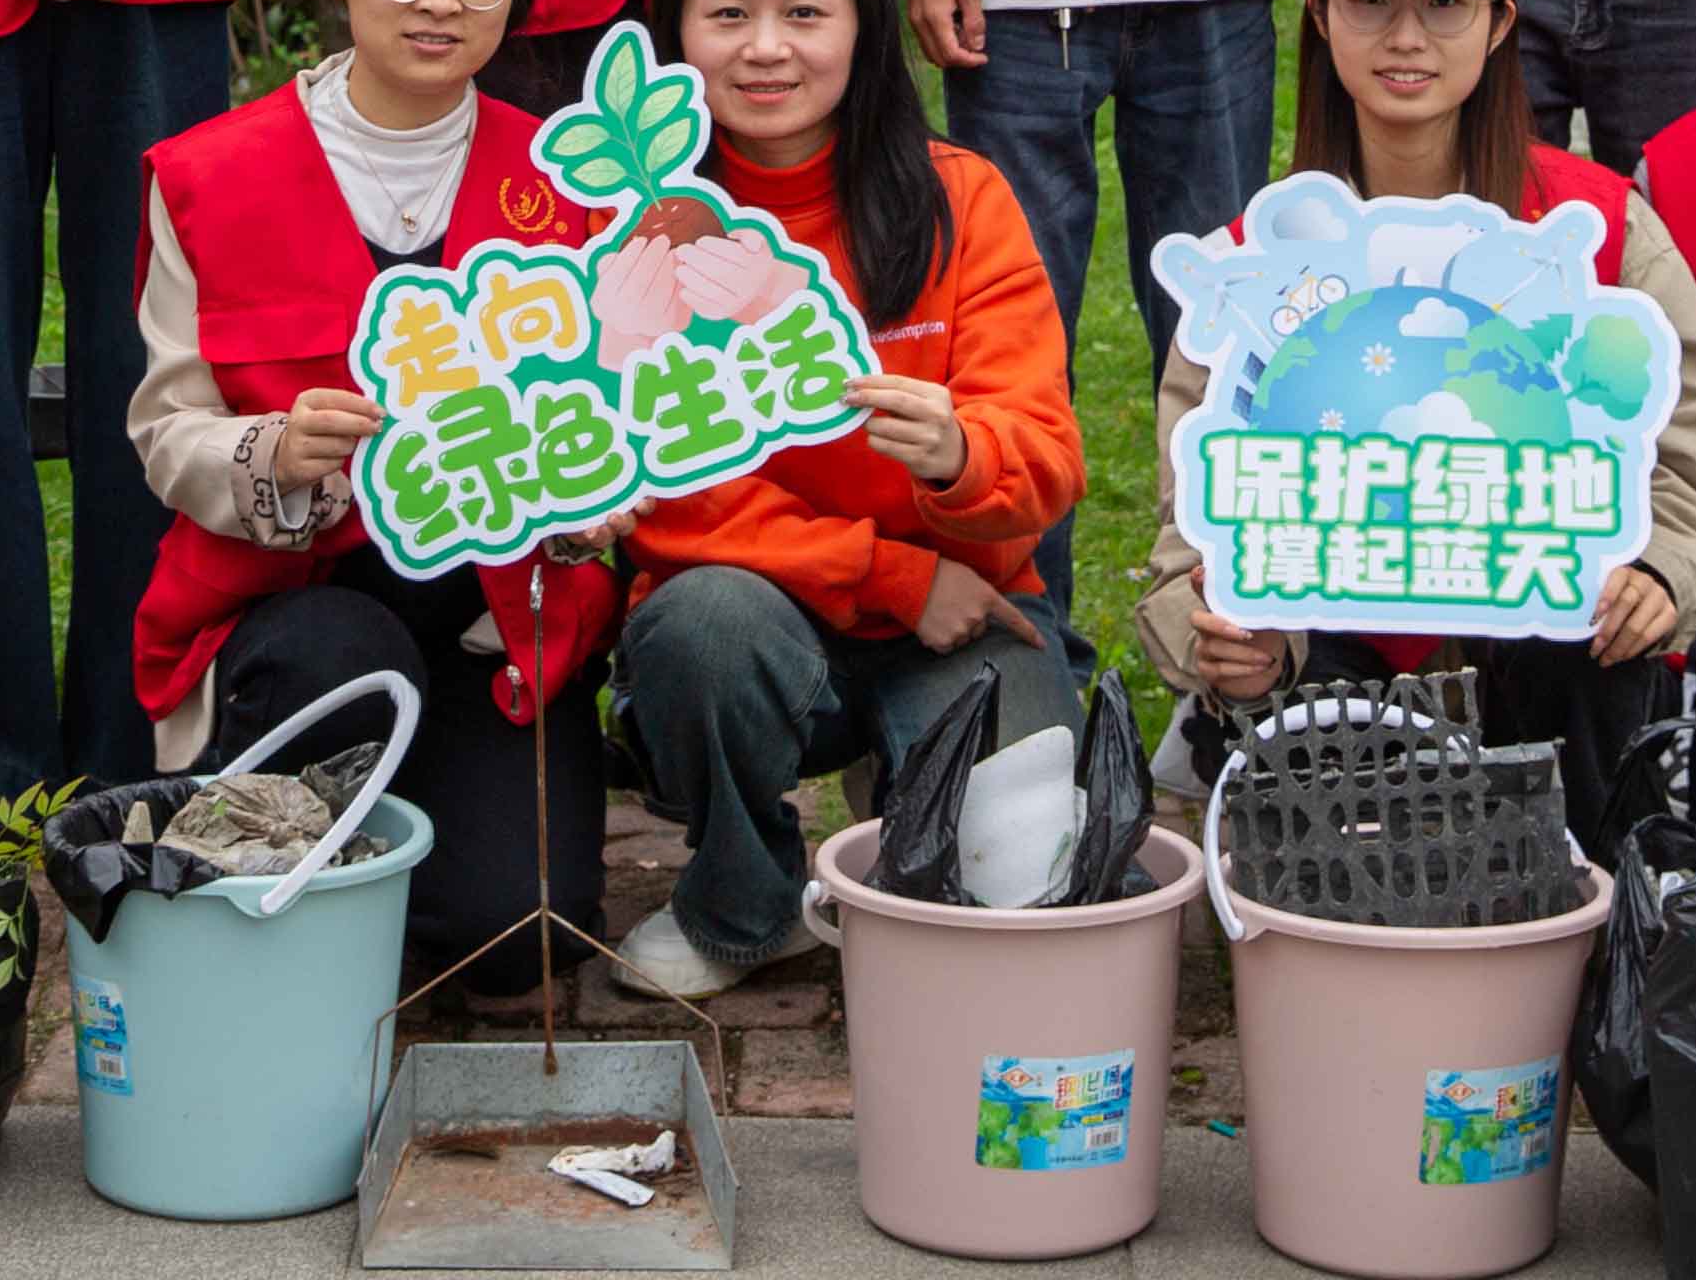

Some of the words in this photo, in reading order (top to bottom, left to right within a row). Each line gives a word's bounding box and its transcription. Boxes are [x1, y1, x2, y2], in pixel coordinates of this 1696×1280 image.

[383, 273, 579, 409] 走向
[384, 302, 851, 547] 绿色生活
[1205, 434, 1617, 531] 保护绿地
[1239, 527, 1579, 605] 撑起蓝天
